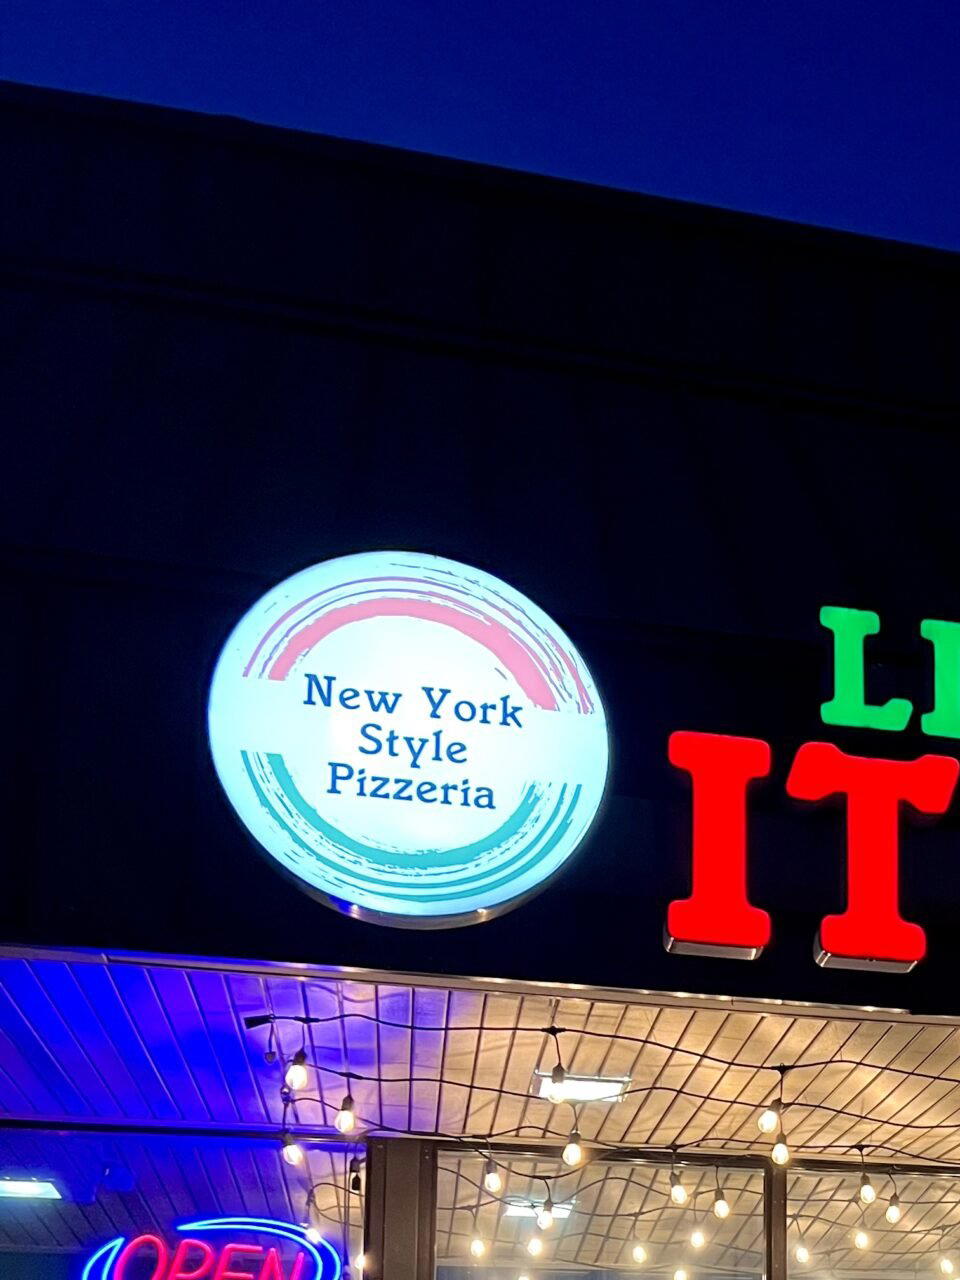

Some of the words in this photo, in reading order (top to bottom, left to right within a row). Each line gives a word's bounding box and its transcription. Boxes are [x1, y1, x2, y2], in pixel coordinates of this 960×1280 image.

[303, 673, 402, 714] New
[422, 687, 524, 729] York
[358, 723, 468, 769] Style
[326, 762, 497, 810] Pizzeria
